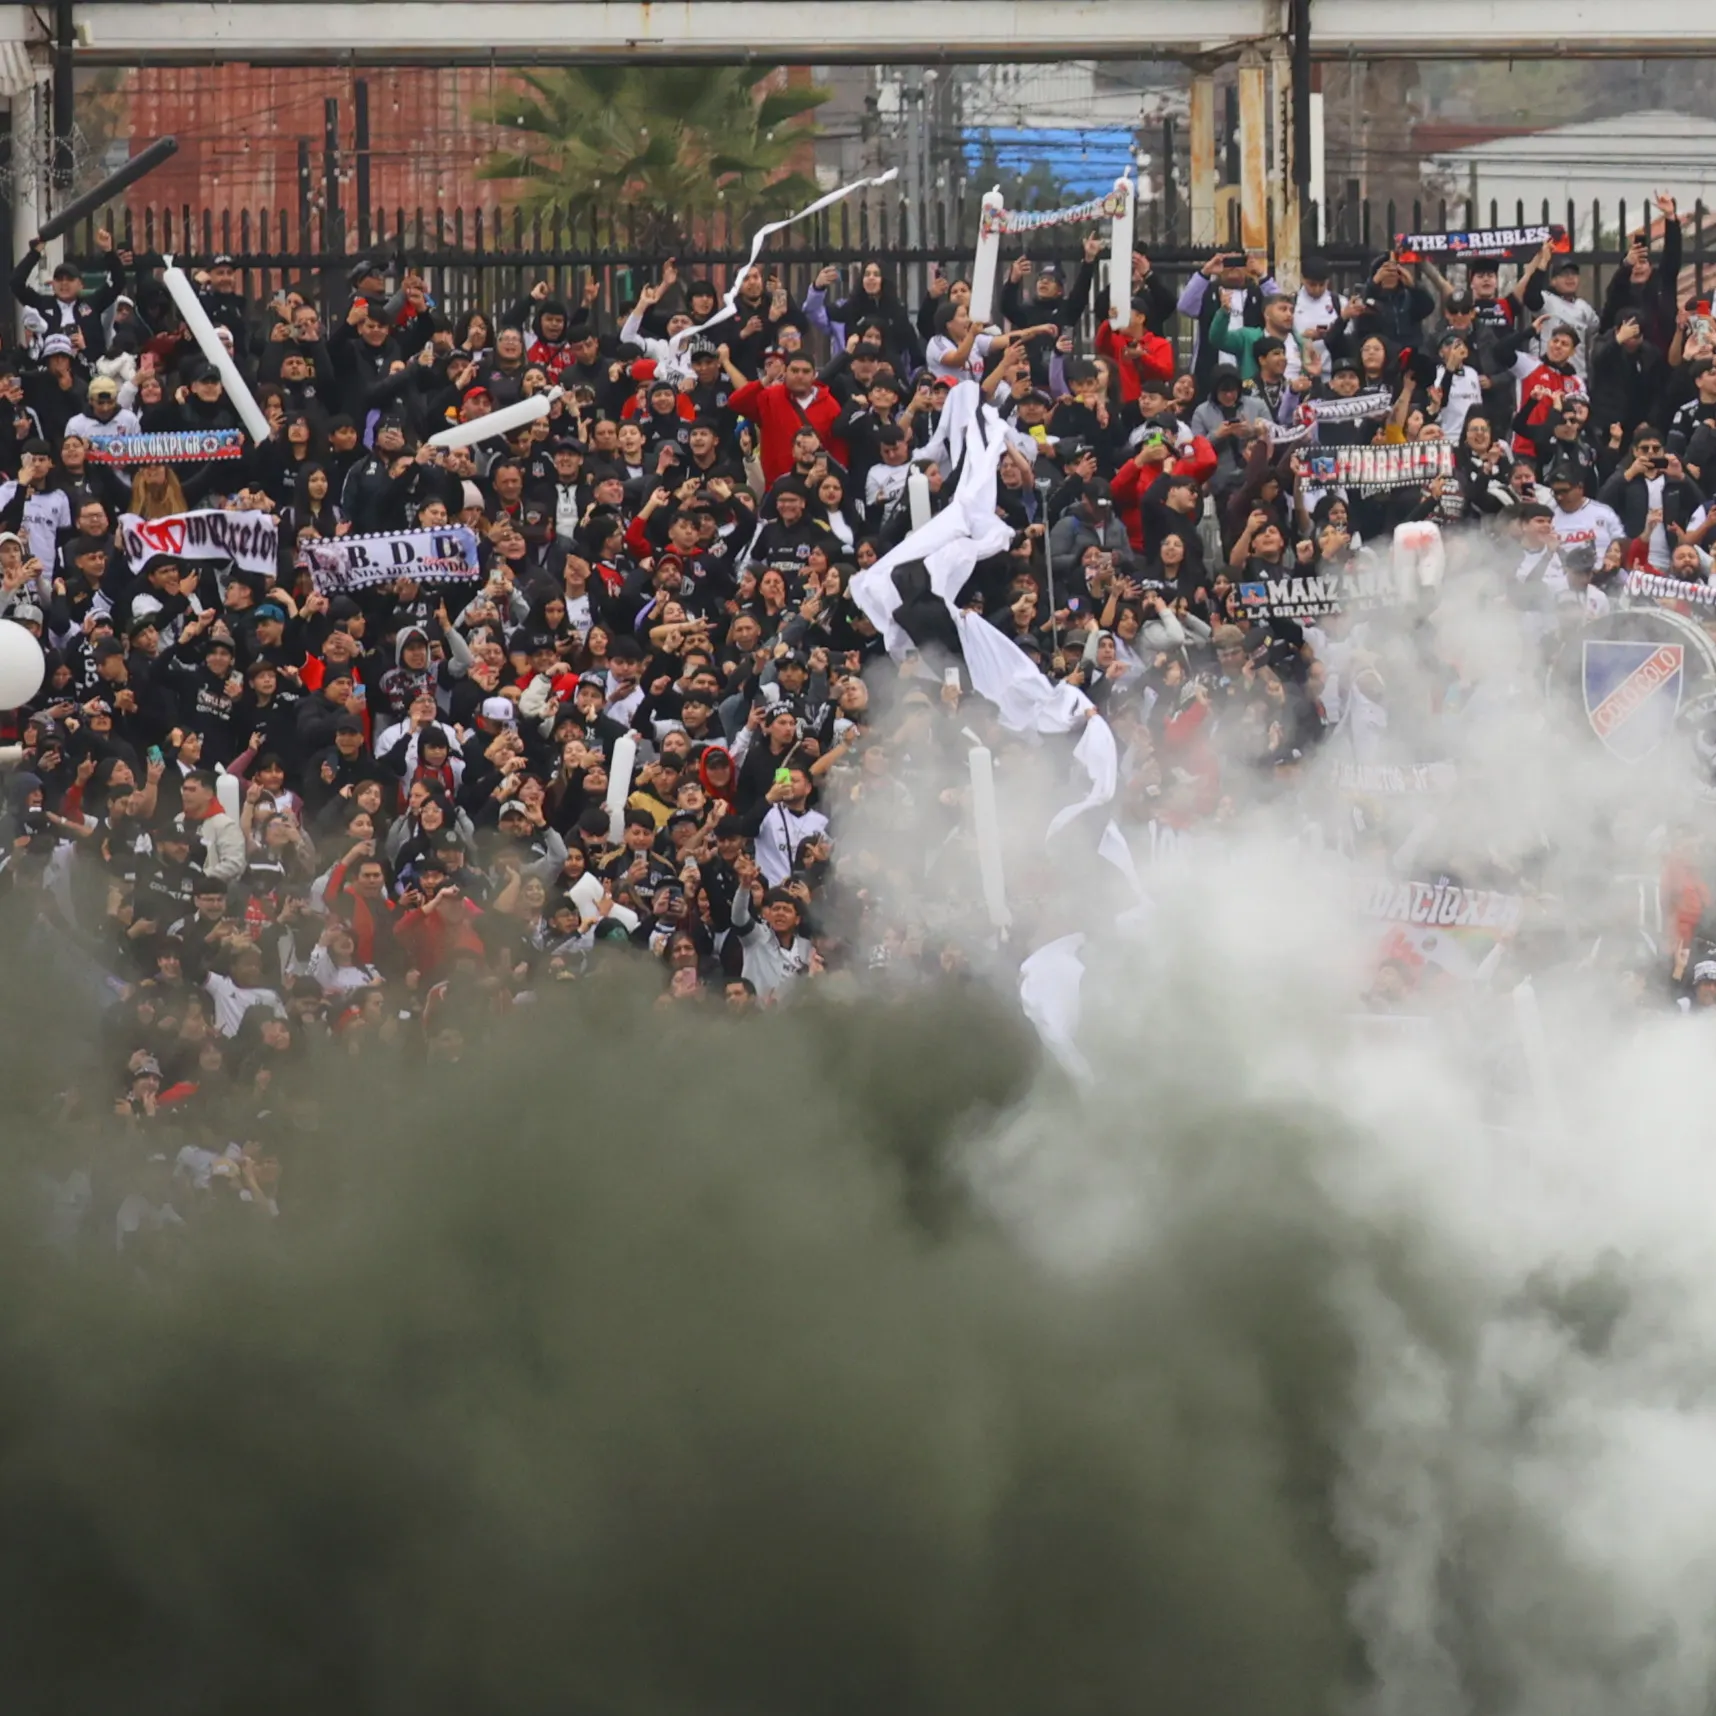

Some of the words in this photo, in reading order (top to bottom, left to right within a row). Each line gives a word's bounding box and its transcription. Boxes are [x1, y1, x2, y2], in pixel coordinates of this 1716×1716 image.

[1408, 235, 1448, 250] THE
[127, 436, 146, 457] LOS
[148, 435, 183, 456] OKXPA
[386, 566, 416, 576] DEL
[1247, 606, 1270, 619] LA
[1273, 602, 1342, 617] GRANJA
[1637, 650, 1678, 689] COLO
